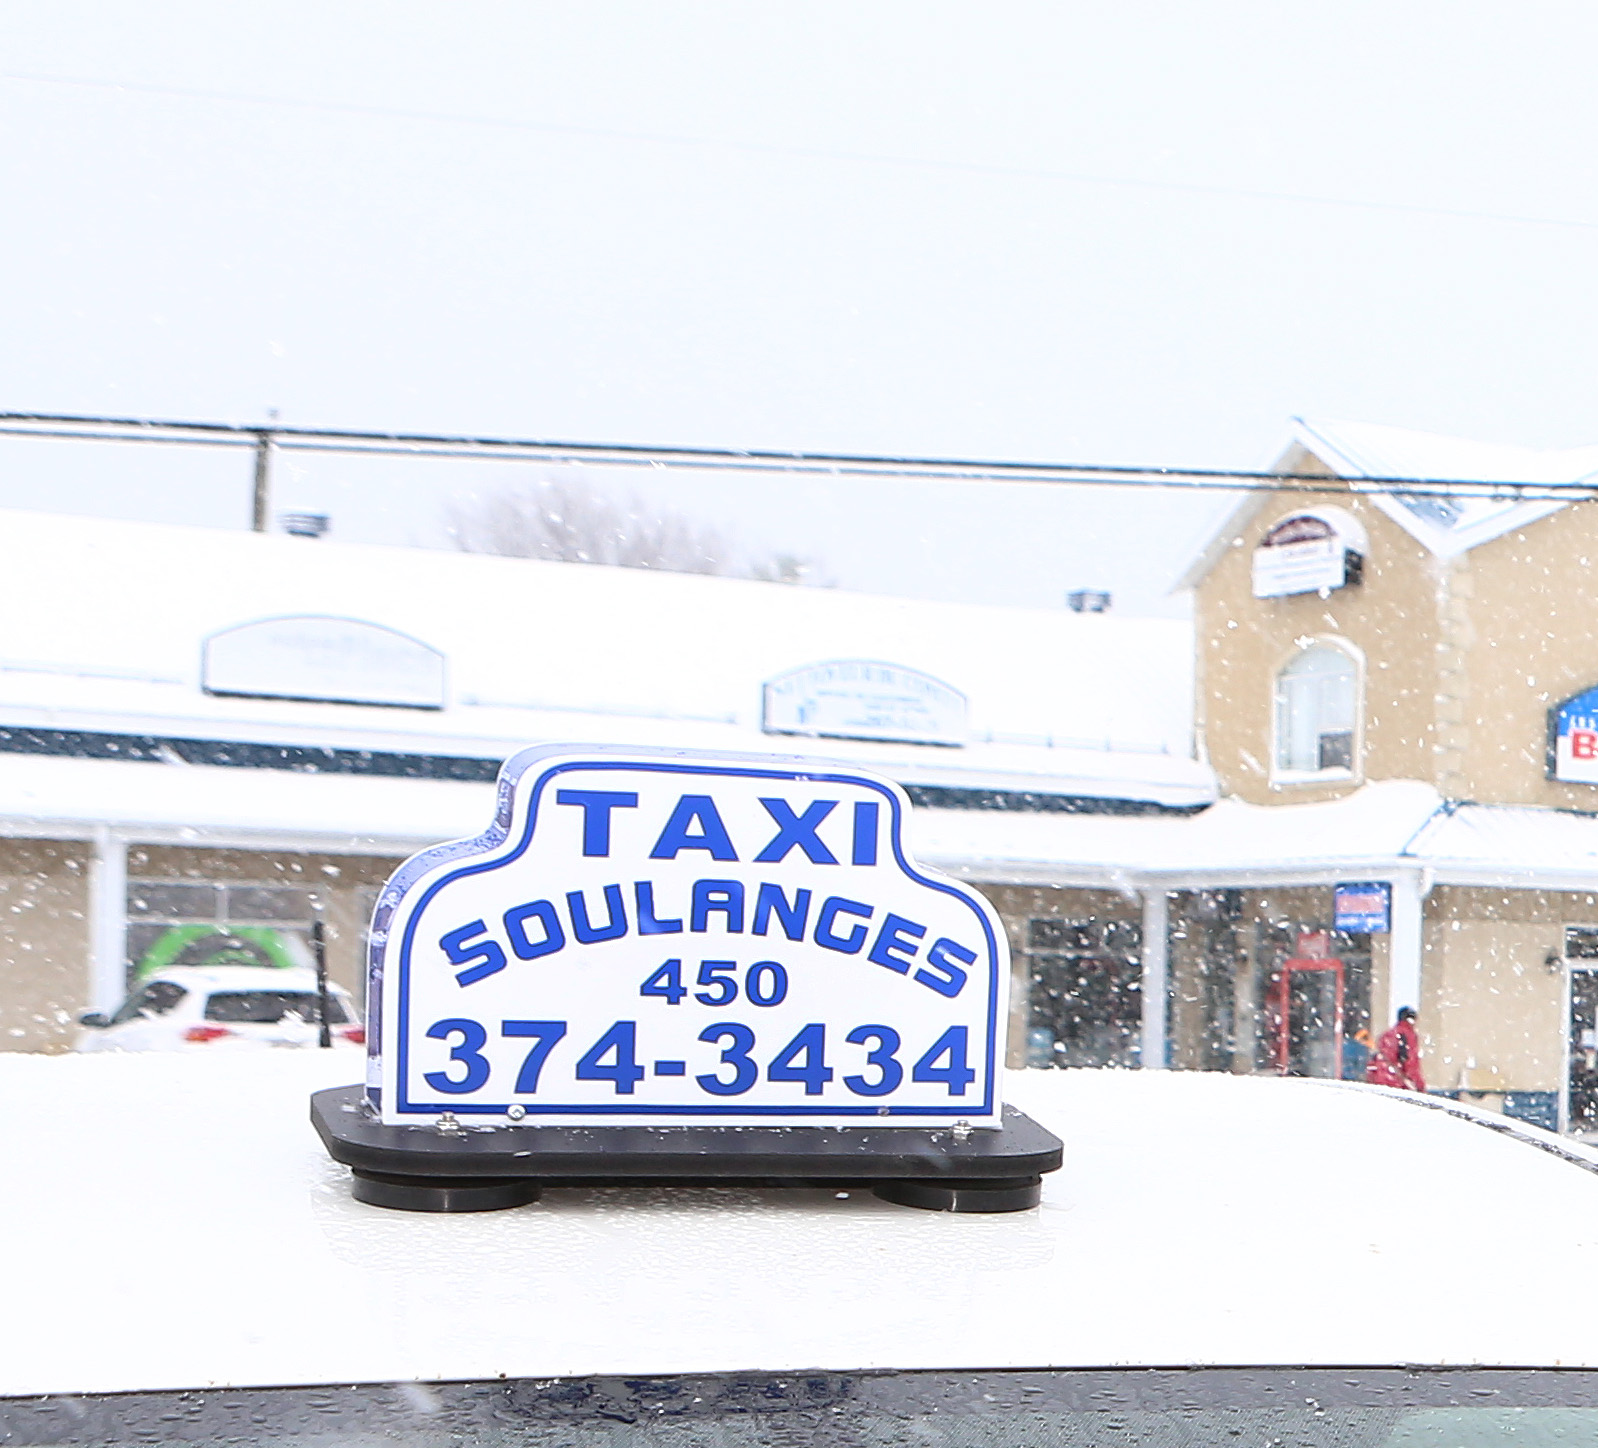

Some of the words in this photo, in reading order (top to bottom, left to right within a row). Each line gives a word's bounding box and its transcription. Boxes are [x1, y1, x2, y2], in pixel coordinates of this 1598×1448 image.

[556, 788, 880, 867] TAXI
[438, 877, 979, 999] SOULANGES
[639, 958, 789, 1008] 450
[422, 1017, 977, 1097] 374-3434
